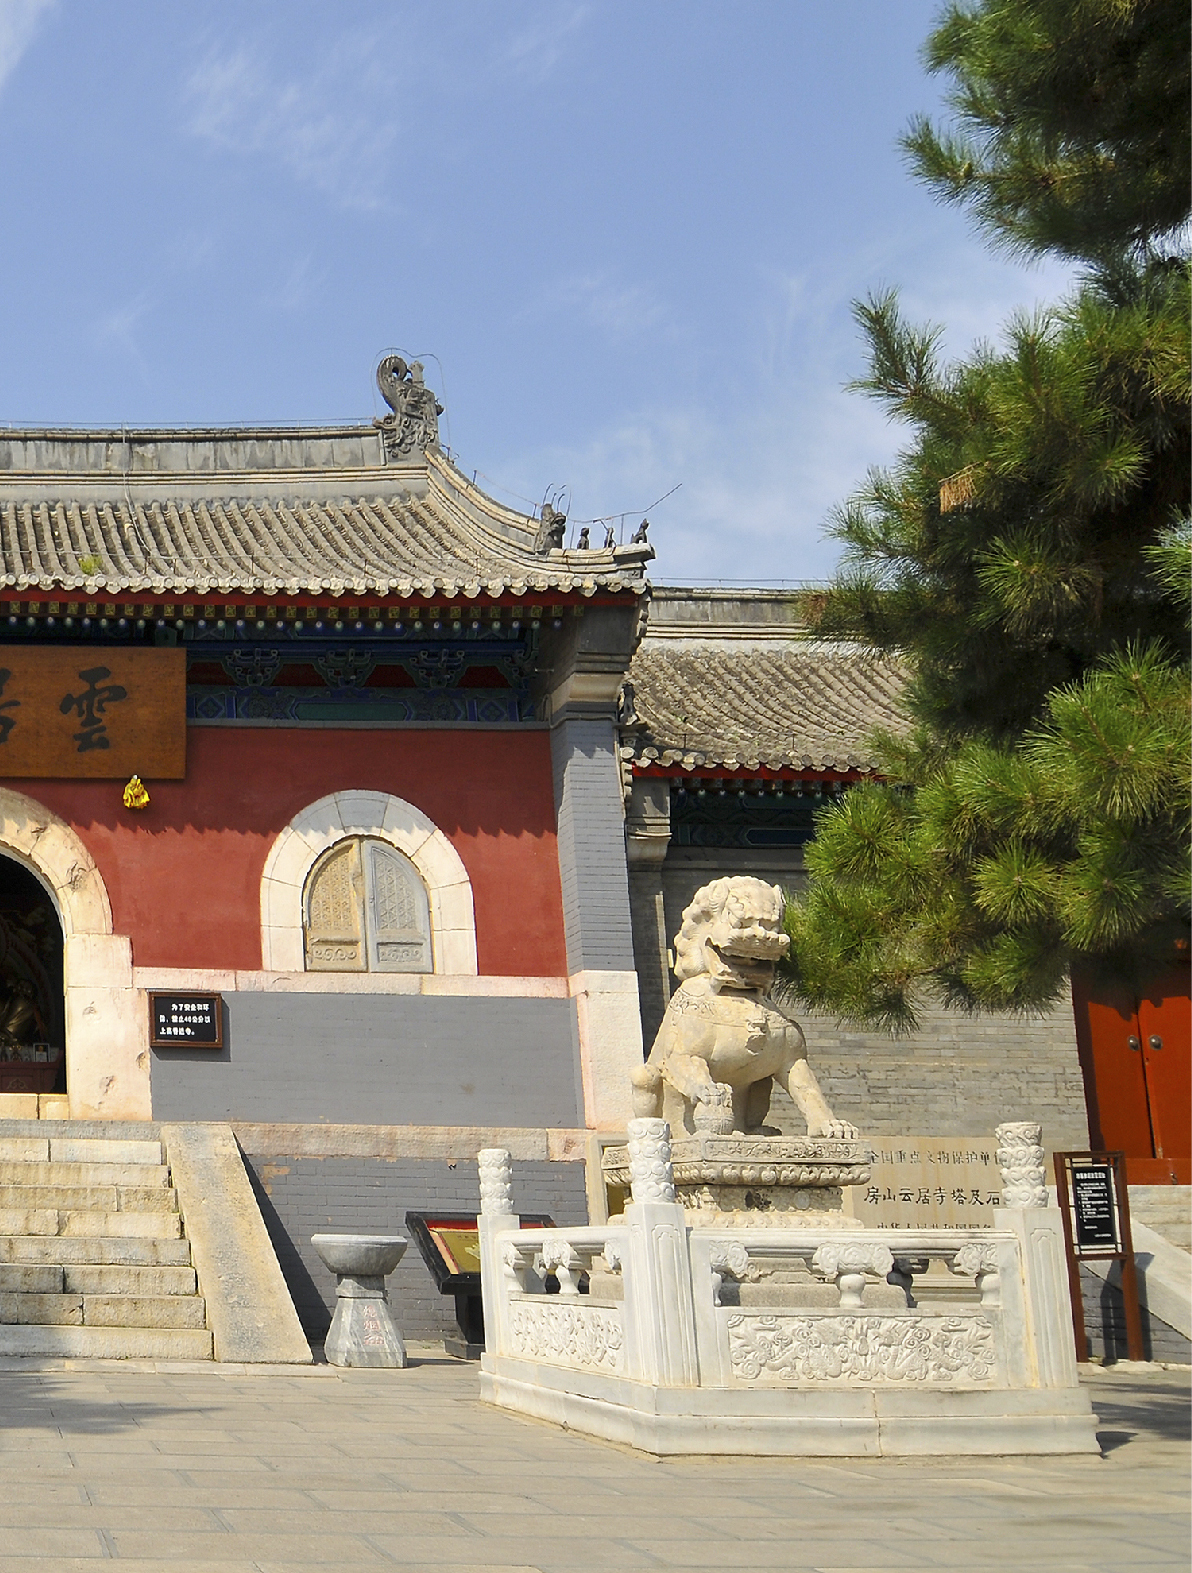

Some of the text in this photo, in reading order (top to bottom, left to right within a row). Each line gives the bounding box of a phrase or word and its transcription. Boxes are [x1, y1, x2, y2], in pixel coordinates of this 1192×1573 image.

[864, 1185, 1001, 1206] 房山云居寺塔及石
